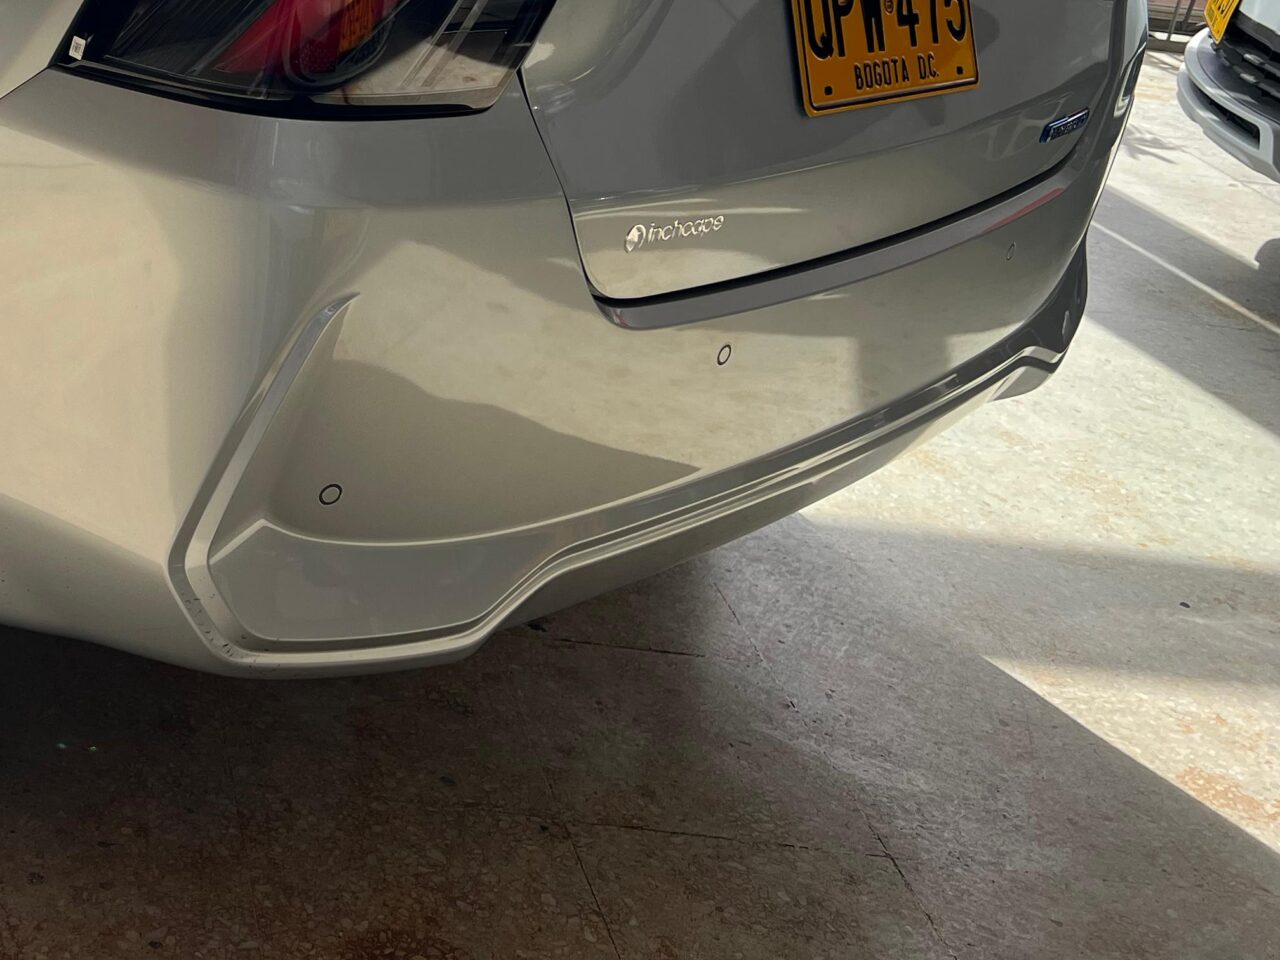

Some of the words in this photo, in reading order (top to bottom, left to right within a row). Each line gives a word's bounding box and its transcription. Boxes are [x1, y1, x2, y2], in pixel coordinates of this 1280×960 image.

[853, 56, 910, 90] BOGOTA
[917, 51, 940, 81] D.C.
[647, 215, 725, 245] inchcape
